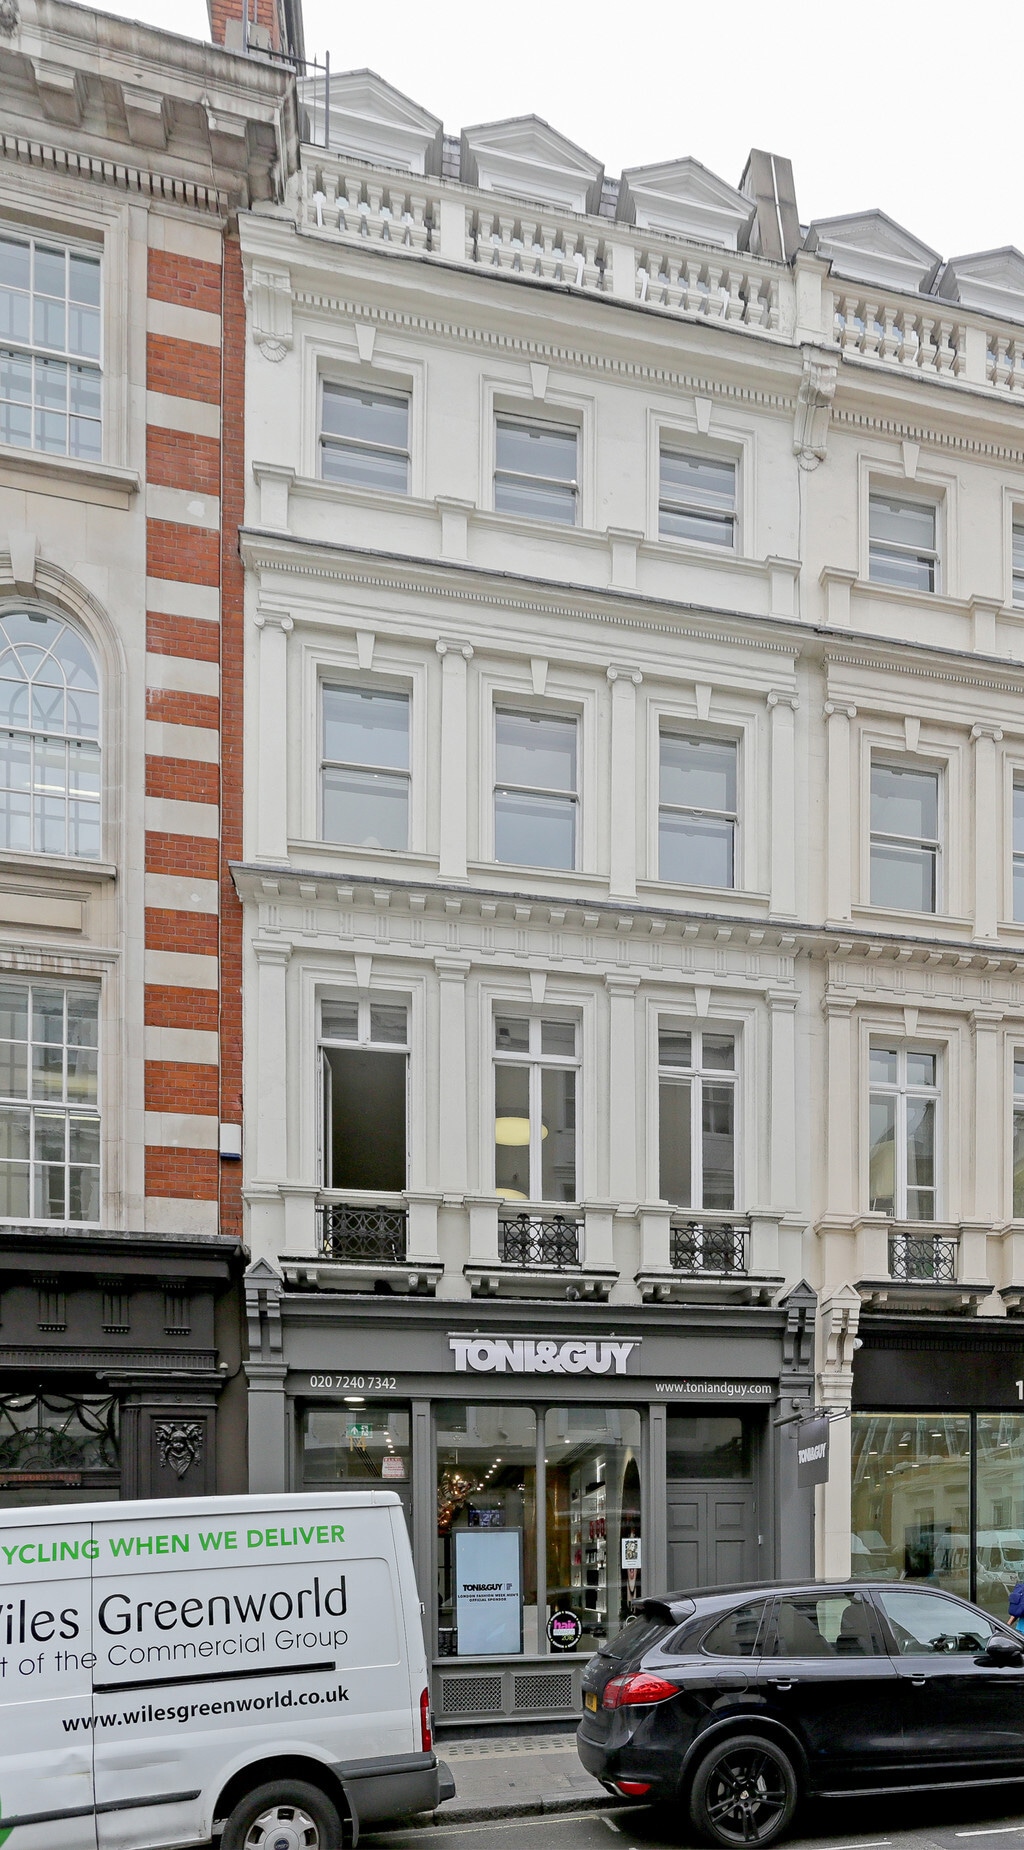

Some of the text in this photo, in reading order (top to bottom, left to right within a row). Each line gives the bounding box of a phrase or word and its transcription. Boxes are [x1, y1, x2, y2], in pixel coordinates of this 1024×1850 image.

[449, 1338, 634, 1374] TONI&GUY
[310, 1375, 397, 1390] 020 7240 7342
[655, 1381, 772, 1396] www.toniandguy.com
[798, 1443, 827, 1464] TONI&GUY
[1, 1525, 346, 1565] YCLING WHEN WE DELIVER
[463, 1583, 503, 1591] TONI&GUY
[0, 1575, 347, 1645] iles Greenworld
[553, 1619, 576, 1629] hair
[19, 1652, 44, 1675] of
[55, 1650, 97, 1672] the
[108, 1632, 265, 1666] Commercial
[275, 1629, 348, 1650] Group
[62, 1685, 349, 1732] www.wilesgreenworld.co.uk
